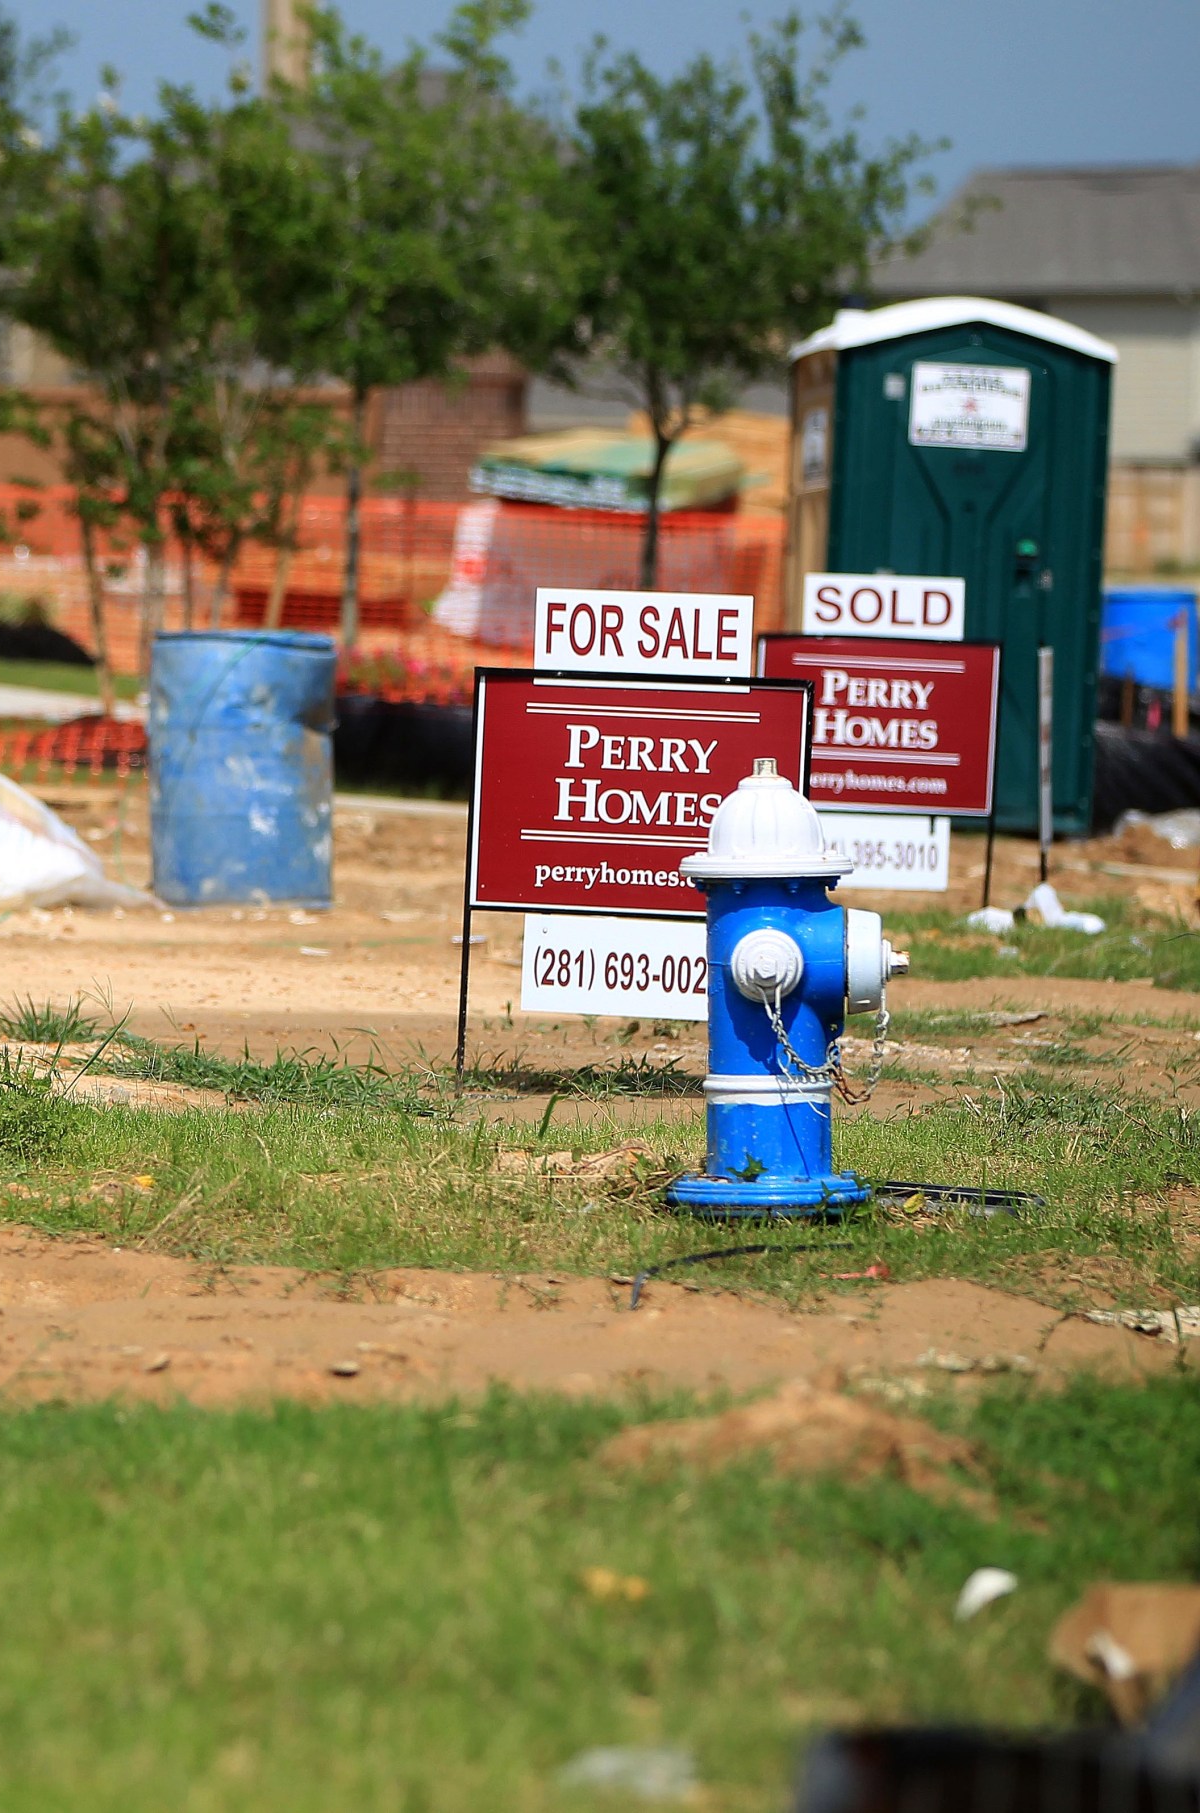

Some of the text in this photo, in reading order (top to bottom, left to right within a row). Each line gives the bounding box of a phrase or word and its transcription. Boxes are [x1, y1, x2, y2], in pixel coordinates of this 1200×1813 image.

[815, 586, 953, 626] SOLD
[545, 602, 739, 661] FOR SALE
[821, 669, 935, 711] PERRY
[564, 723, 718, 774] PERRY
[813, 709, 939, 750] HOMES
[553, 777, 723, 828] HOMES
[810, 768, 947, 795] erryhomes.com
[533, 945, 707, 994] (281) 693-002
